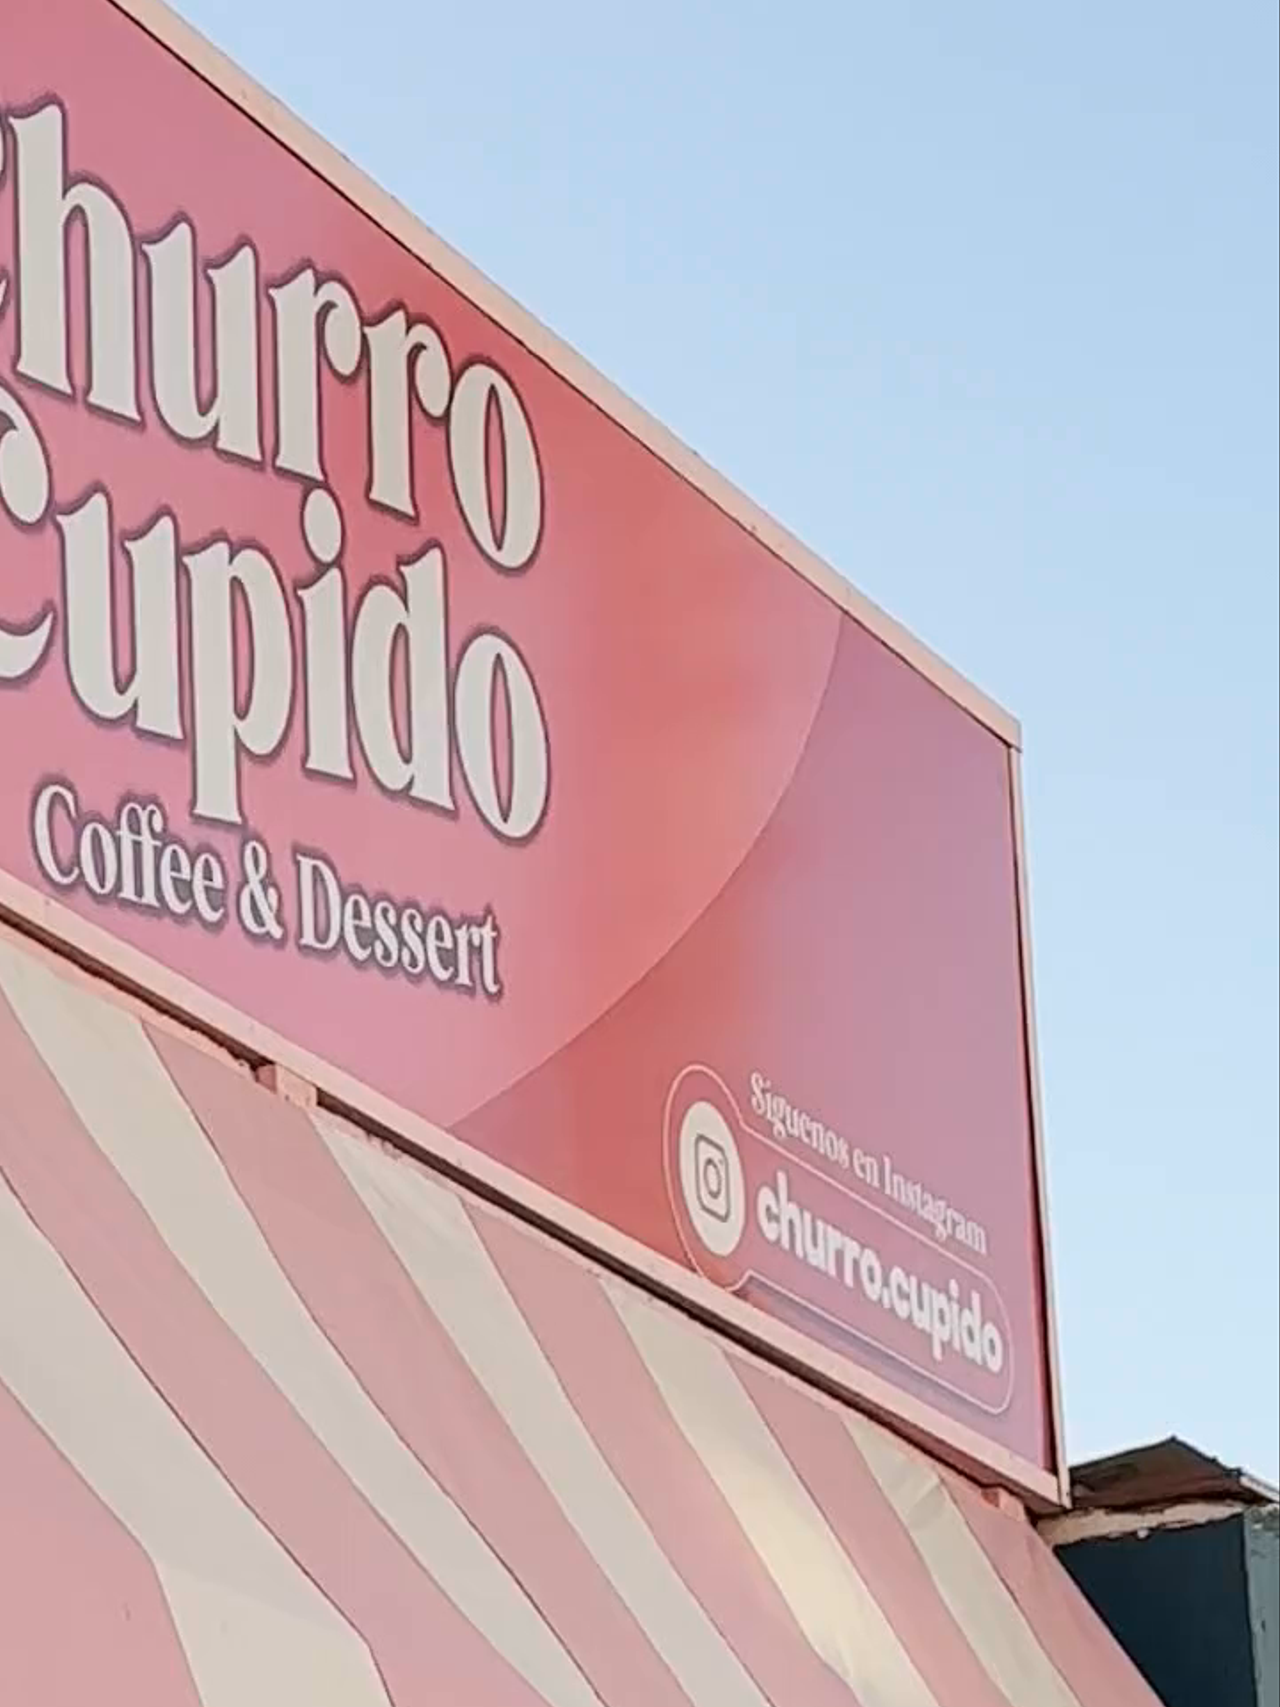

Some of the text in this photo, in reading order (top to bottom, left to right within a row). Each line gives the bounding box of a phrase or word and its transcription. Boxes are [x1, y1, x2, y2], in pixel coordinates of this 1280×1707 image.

[34, 784, 502, 995] Coffee & Dessert
[756, 1170, 1004, 1374] churro.cupido
[853, 1145, 880, 1189] en
[883, 1156, 988, 1255] Instagram
